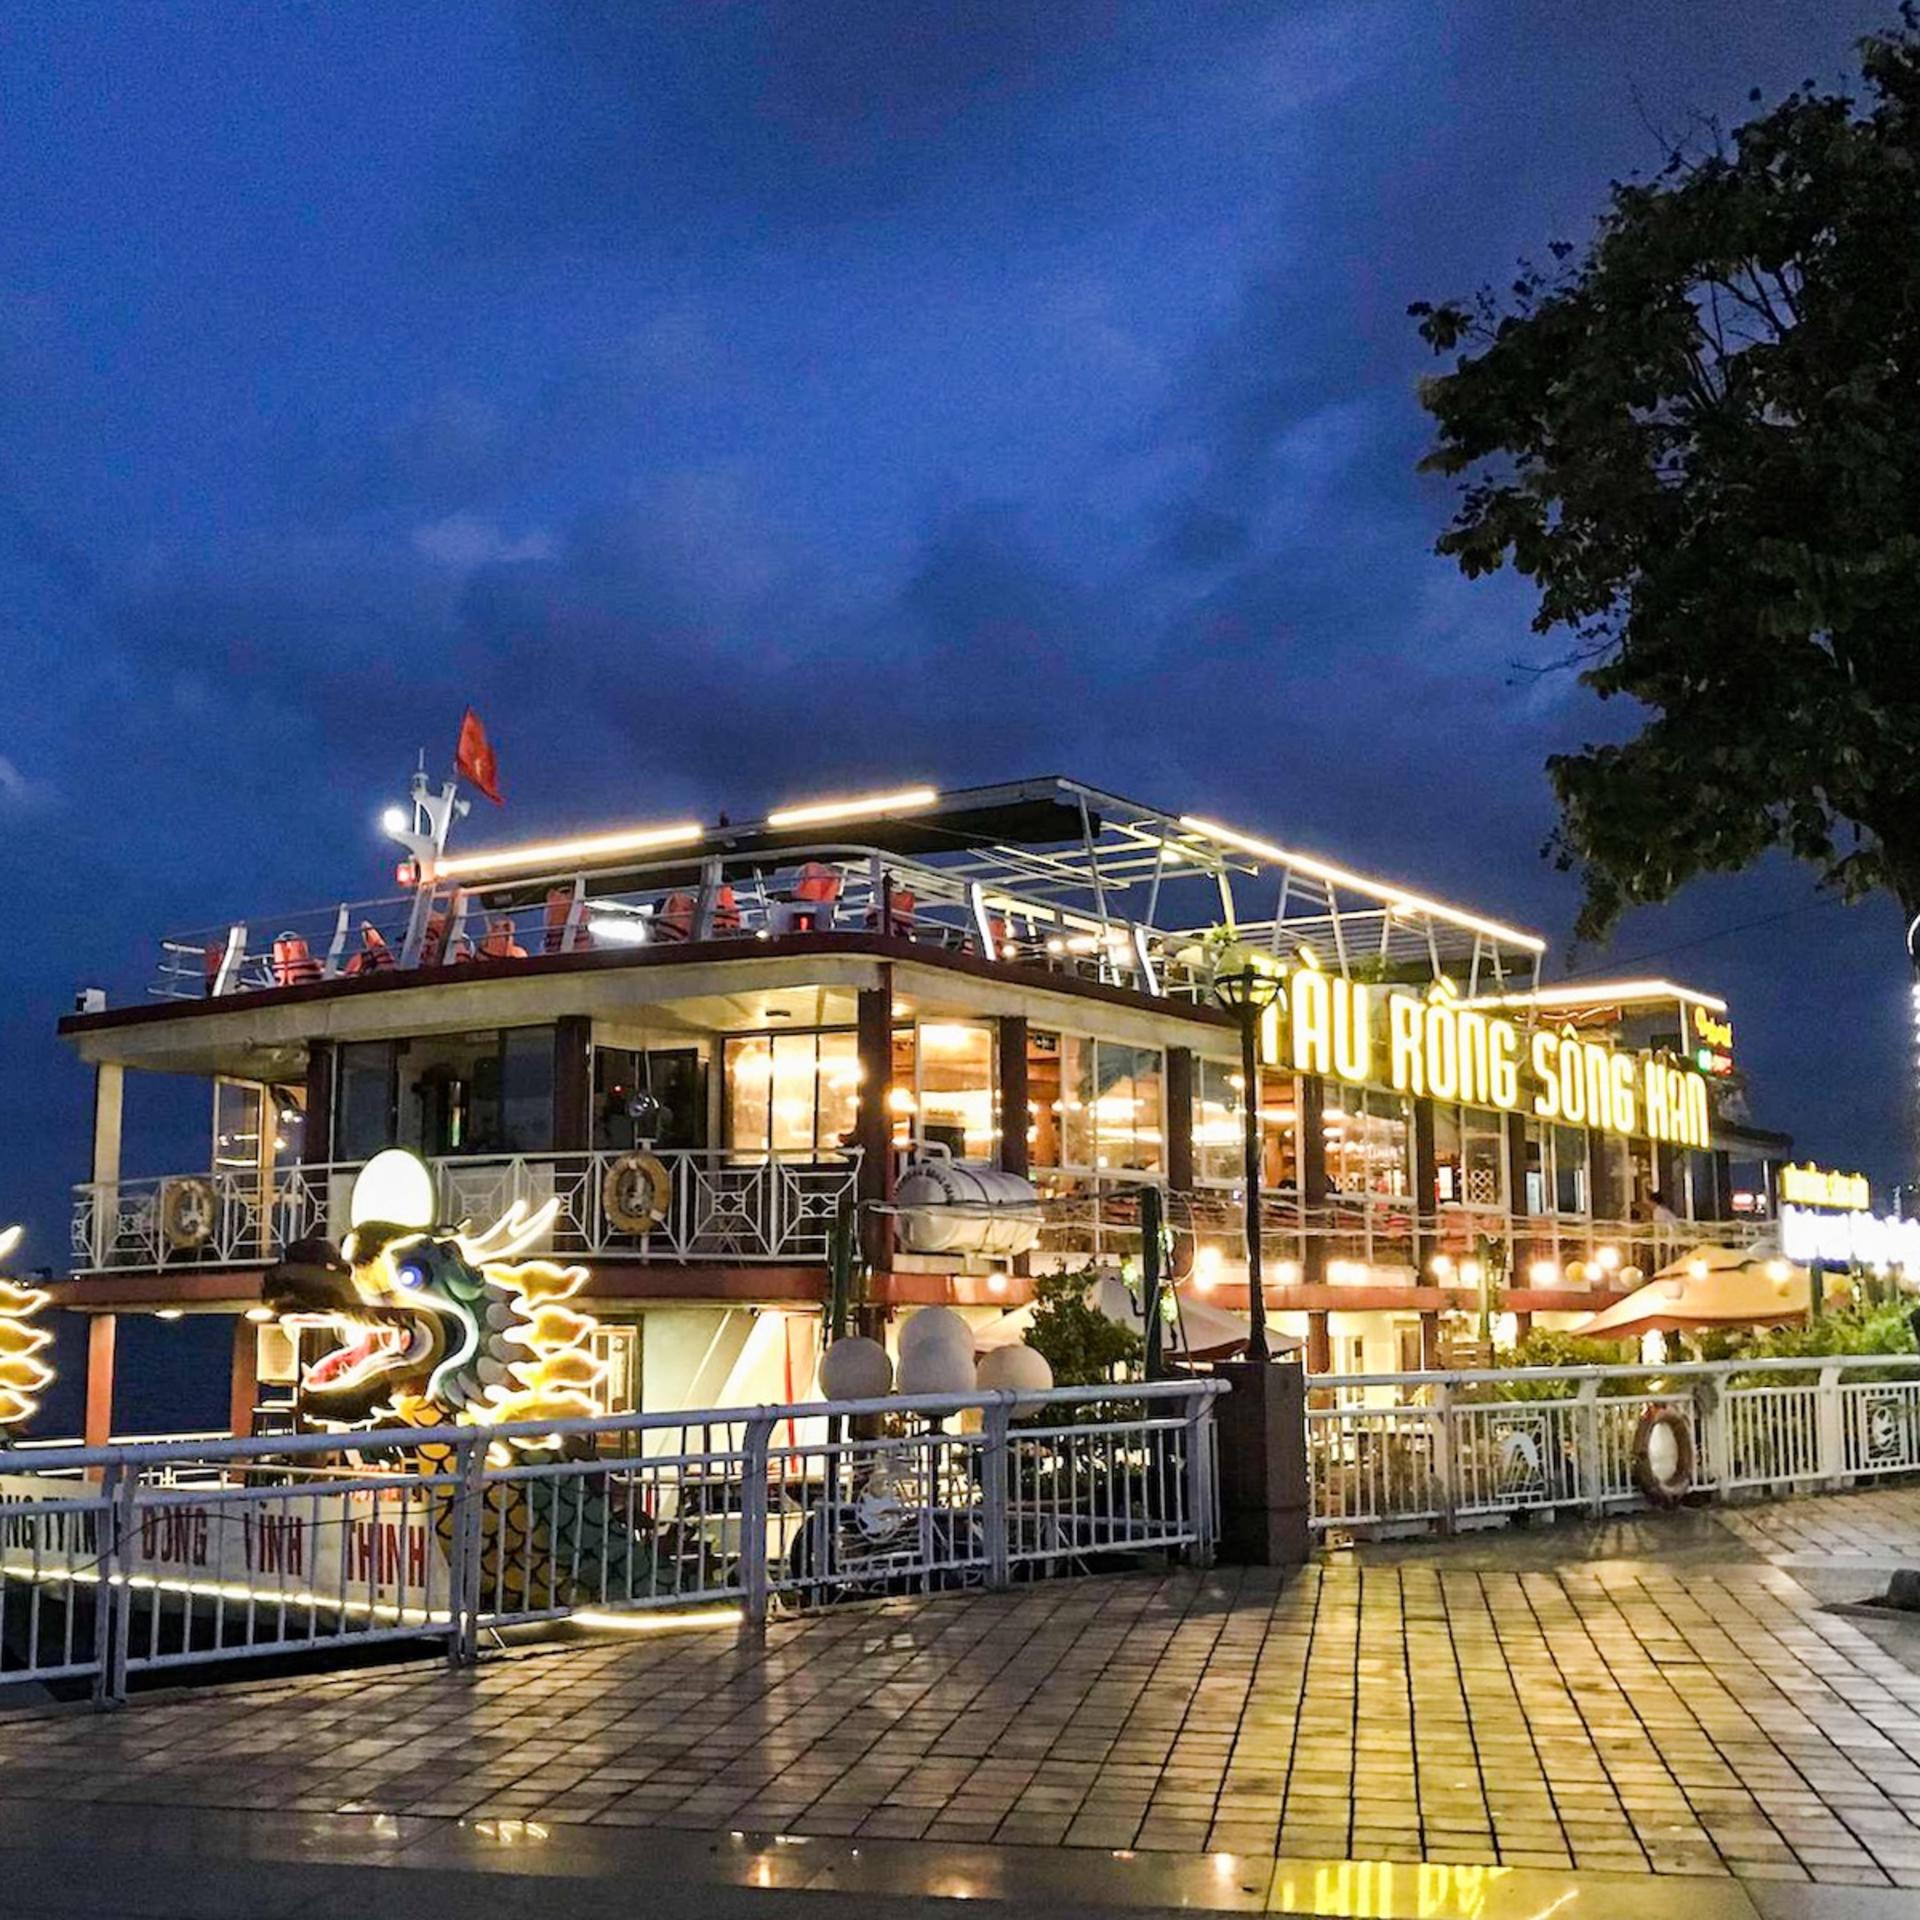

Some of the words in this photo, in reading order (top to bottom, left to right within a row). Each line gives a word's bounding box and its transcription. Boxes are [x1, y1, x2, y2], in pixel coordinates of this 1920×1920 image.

[1251, 946, 1369, 1082] TÀU
[1389, 974, 1518, 1109] RỒNG
[1532, 1022, 1635, 1133] SÔNG
[1645, 1051, 1710, 1149] HÀN
